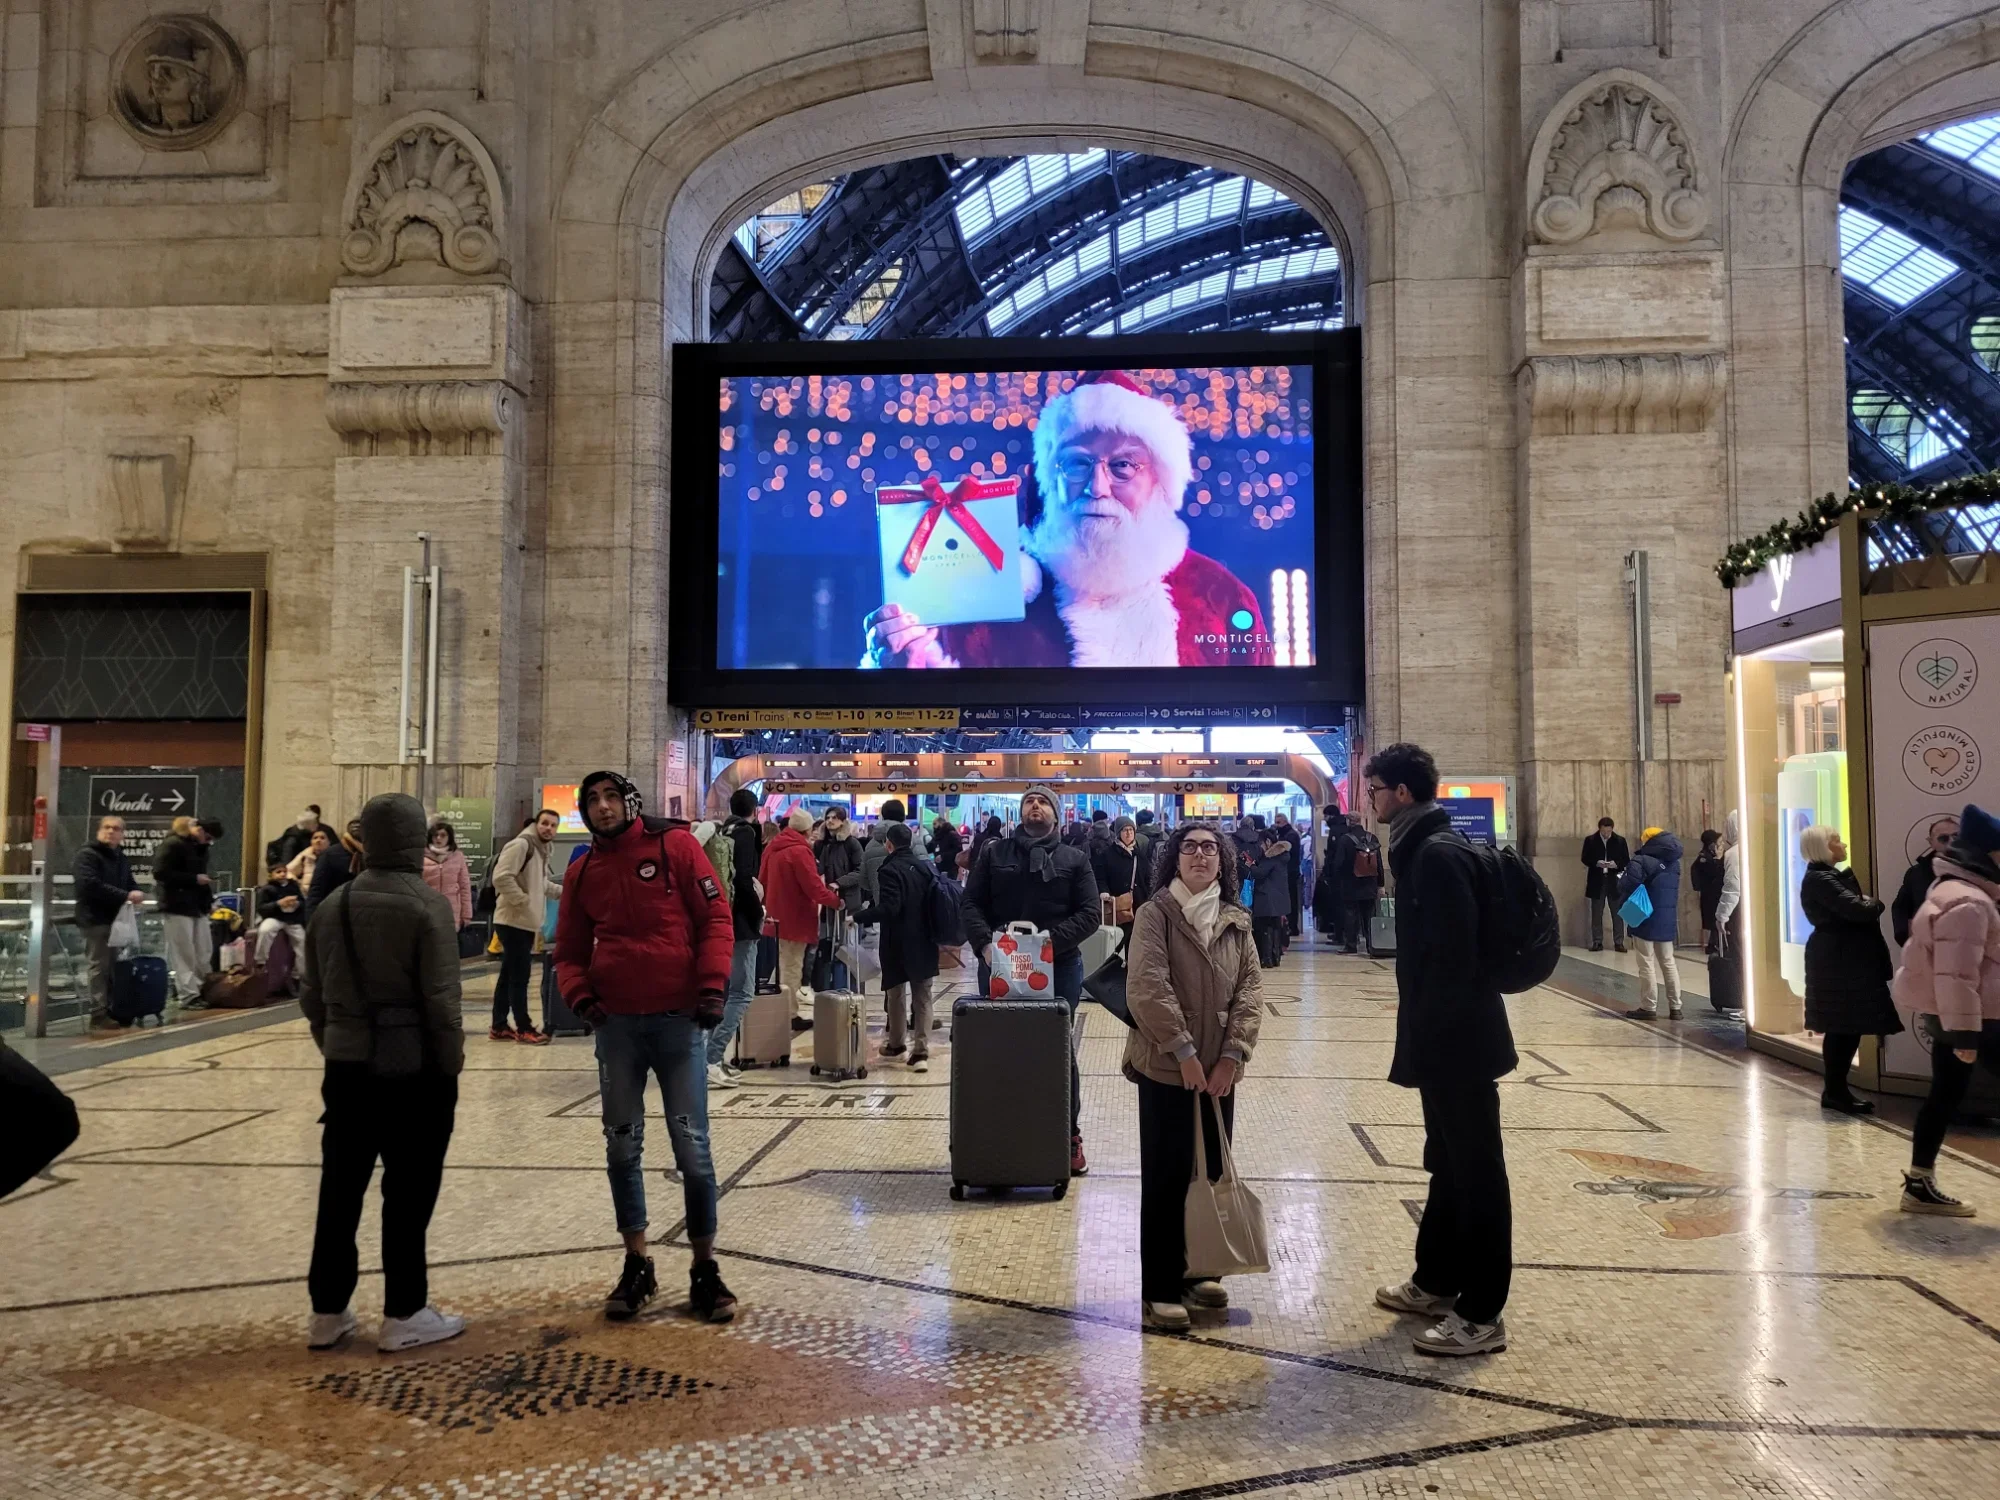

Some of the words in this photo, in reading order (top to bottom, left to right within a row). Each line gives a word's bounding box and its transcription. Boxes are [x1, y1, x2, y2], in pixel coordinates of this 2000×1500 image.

[1928, 668, 1973, 703] NATURAL
[716, 711, 750, 721] Treni
[754, 711, 785, 721] Trains
[836, 711, 865, 720] 1-10
[918, 711, 954, 720] 11-22
[1173, 708, 1205, 716] Servizi
[1207, 708, 1230, 716] Toilets
[1910, 730, 1968, 755] MINDFULLY
[1931, 751, 1975, 790] PRODUCED
[101, 789, 154, 811] Venchi
[1010, 954, 1031, 963] ROSSO
[1015, 962, 1034, 971] POMO
